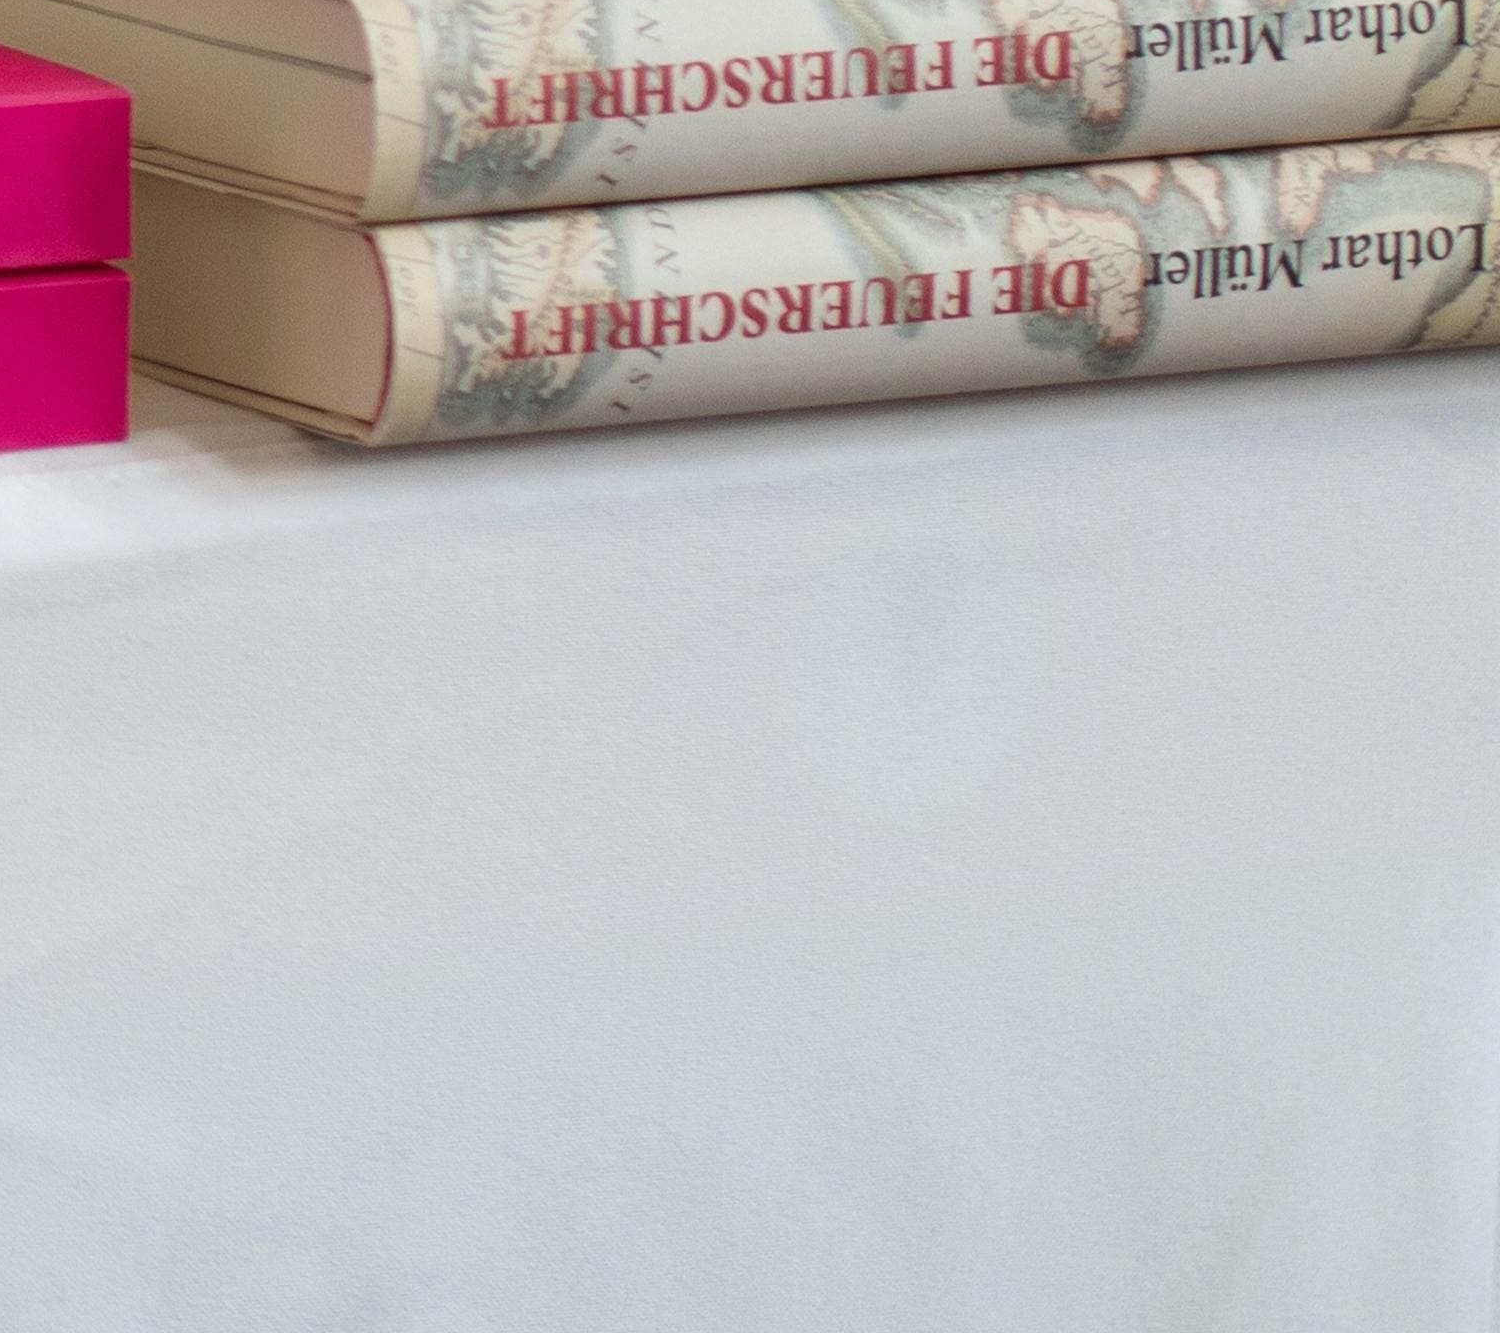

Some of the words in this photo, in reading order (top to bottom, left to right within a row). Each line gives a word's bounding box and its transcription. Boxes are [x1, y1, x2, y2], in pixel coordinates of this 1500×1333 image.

[974, 28, 1075, 89] DIE
[1128, 7, 1288, 77] Müller
[479, 34, 958, 130] FEUERSCHRIFT
[1142, 236, 1305, 302] Müller
[1321, 221, 1490, 280] Lothar
[500, 266, 975, 362] FEUERSCHRIFT
[992, 256, 1094, 317] DIE
